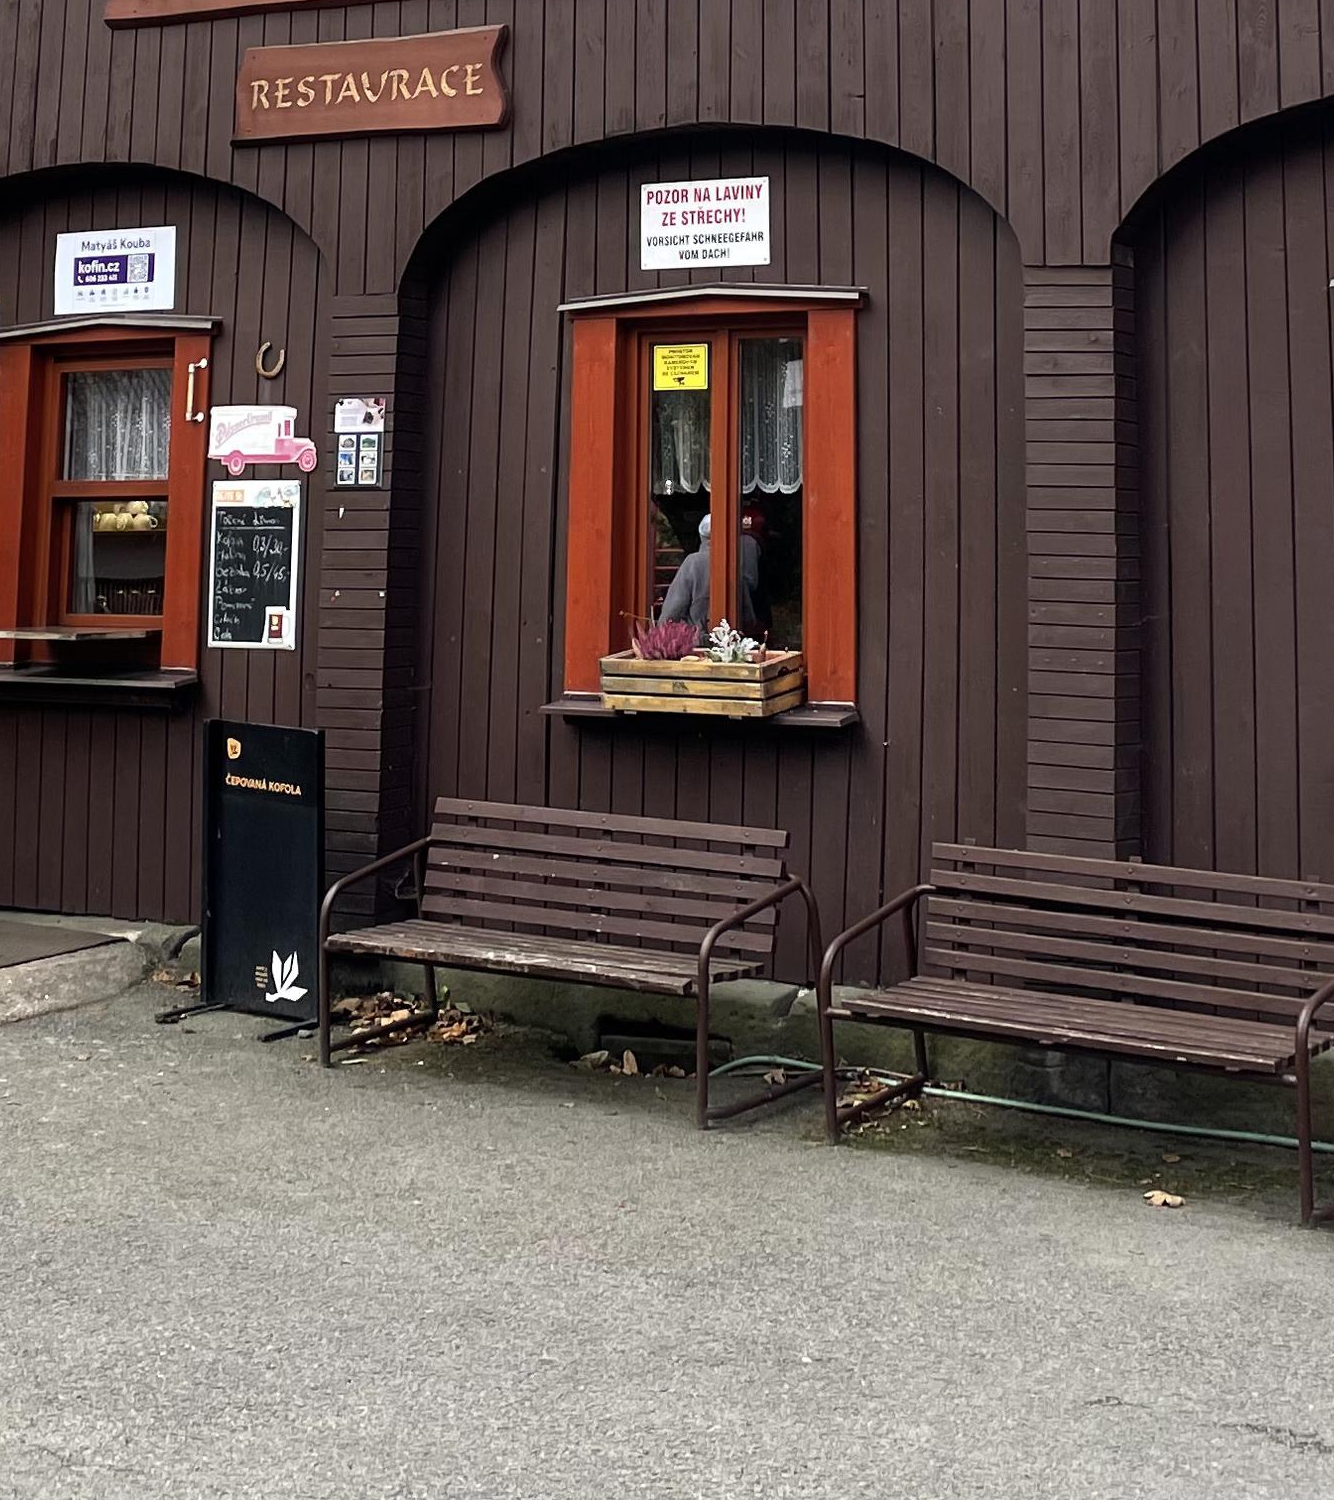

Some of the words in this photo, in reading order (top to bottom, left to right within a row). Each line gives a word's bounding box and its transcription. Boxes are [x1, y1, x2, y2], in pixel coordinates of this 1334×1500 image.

[250, 61, 485, 112] RESTAURACE
[646, 188, 689, 206] POZOR
[693, 187, 711, 202] NA
[715, 184, 763, 202] LAVINY
[661, 211, 677, 227] ZE
[681, 206, 746, 226] STŘECHY!
[81, 238, 118, 253] Matyáš
[120, 237, 151, 250] Kouba
[646, 234, 690, 248] VORSICHT
[692, 231, 765, 246] SCHNEEGEFAHR
[678, 249, 699, 261] VOM
[702, 248, 731, 260] DACH!
[78, 260, 121, 275] kofin.cz
[225, 772, 267, 791] ČEPOVANÁ
[268, 781, 302, 796] KOFOLA
